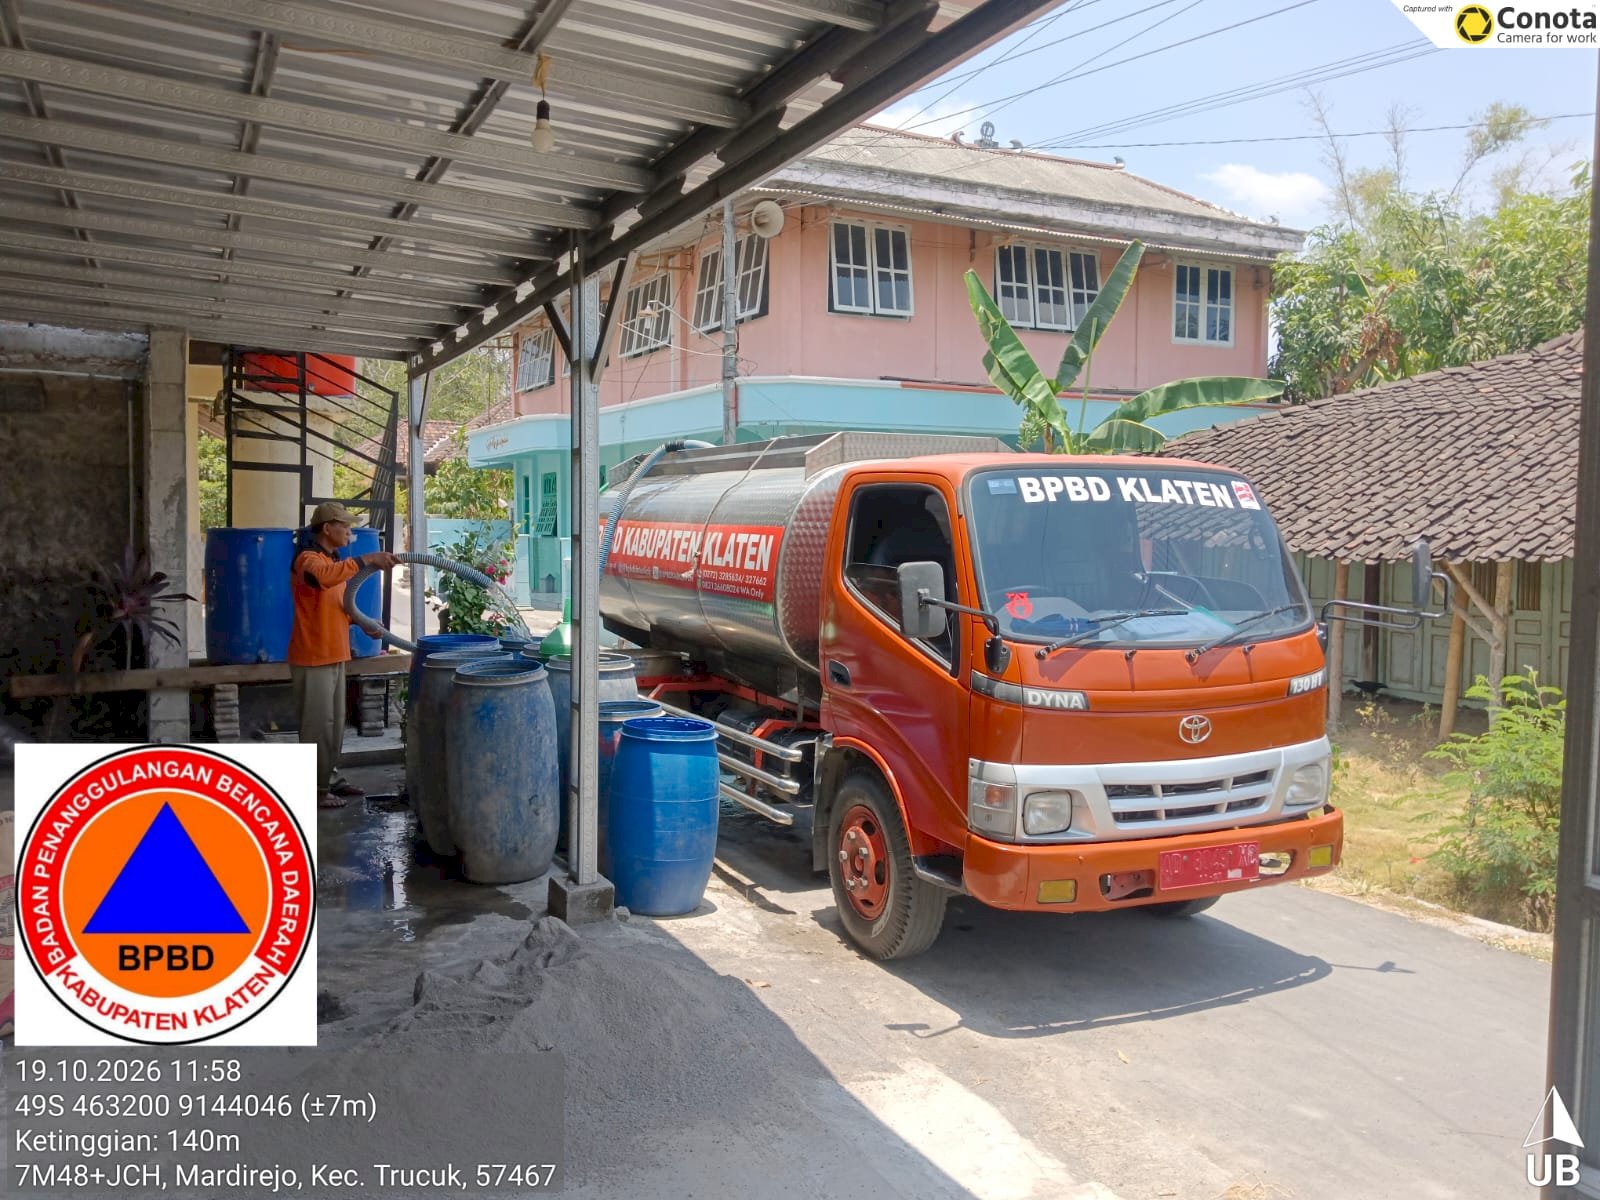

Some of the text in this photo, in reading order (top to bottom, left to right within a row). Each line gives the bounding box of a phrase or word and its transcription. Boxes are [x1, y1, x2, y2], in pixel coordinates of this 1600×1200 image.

[1017, 476, 1111, 503] BPBD
[1116, 476, 1235, 509] KLATEN
[622, 527, 701, 563] KABUPATEN
[701, 530, 774, 571] KLATEN
[750, 587, 764, 600] Only
[1027, 691, 1084, 710] DYNA
